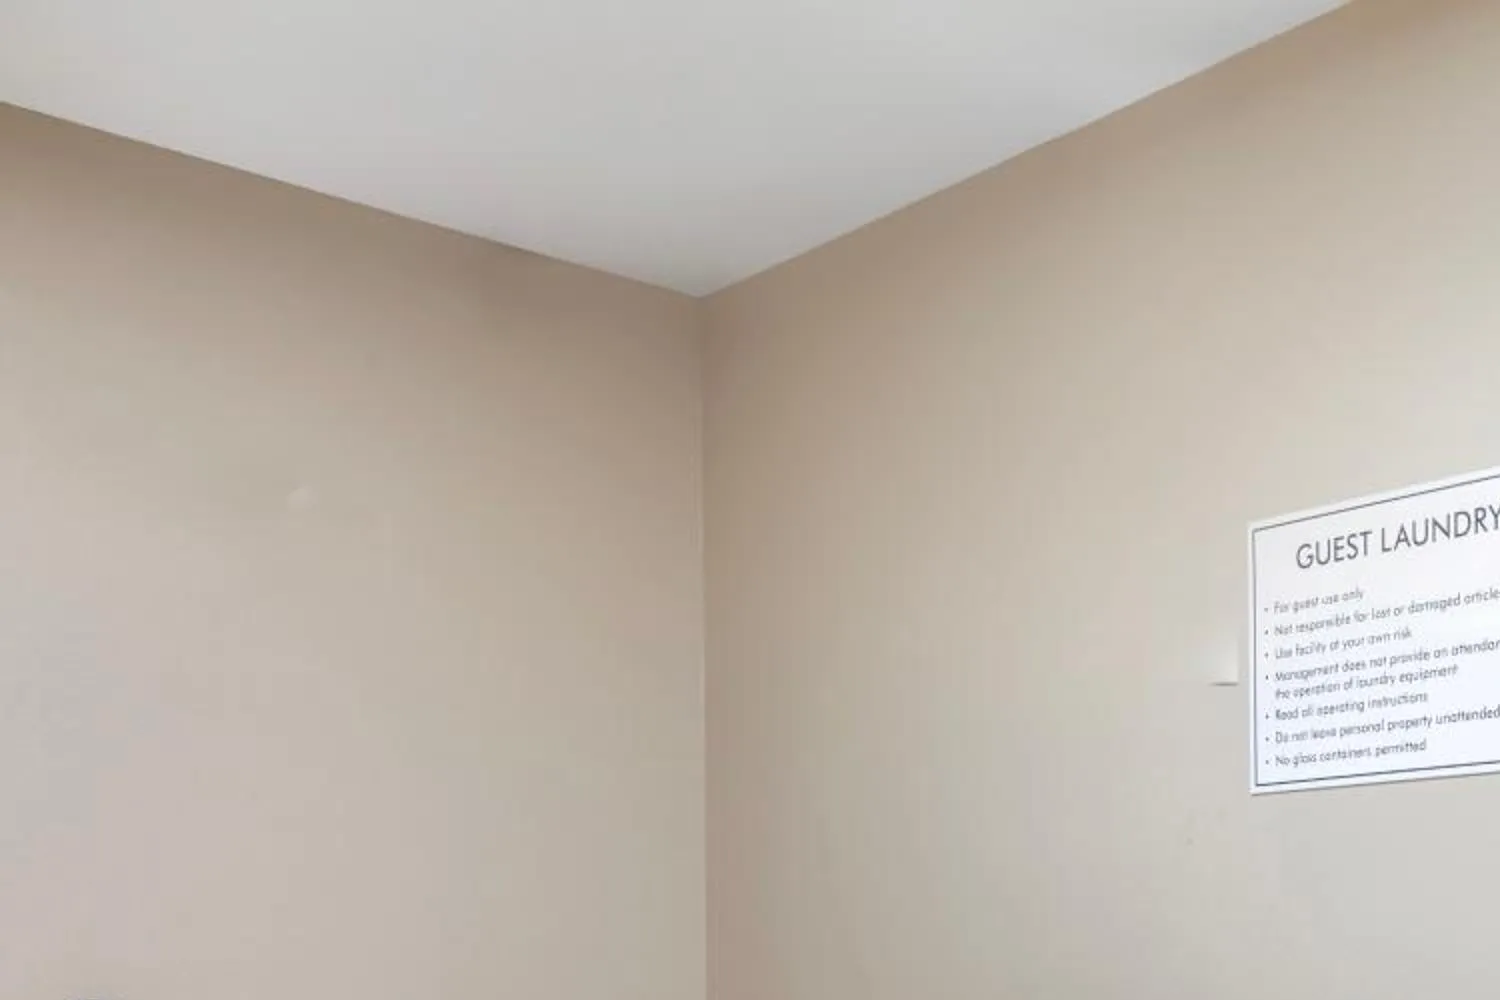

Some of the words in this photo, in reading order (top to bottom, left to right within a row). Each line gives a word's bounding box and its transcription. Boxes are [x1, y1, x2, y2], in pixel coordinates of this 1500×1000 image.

[1296, 530, 1372, 569] GUEST
[1274, 600, 1289, 613] For
[1292, 596, 1318, 614] guest
[1321, 594, 1340, 605] use
[1341, 587, 1364, 603] only
[1275, 624, 1293, 635] Not
[1296, 613, 1351, 634] responsible
[1353, 610, 1370, 622] for
[1371, 607, 1391, 620] lost
[1393, 606, 1405, 616] or
[1408, 592, 1460, 615] damaged
[1275, 647, 1293, 659] Use
[1296, 640, 1327, 655] facility
[1329, 640, 1340, 651] at
[1341, 637, 1365, 650] your
[1367, 633, 1391, 645] own
[1393, 627, 1411, 640] risk
[1275, 663, 1339, 681] Management
[1341, 659, 1367, 673] does
[1370, 656, 1387, 668] not
[1389, 648, 1430, 668] provide
[1433, 647, 1448, 658] an
[1275, 687, 1290, 699] the
[1293, 682, 1341, 698] operation
[1343, 677, 1354, 690] of
[1356, 672, 1396, 689] laundry
[1399, 664, 1459, 684] equipment
[1275, 706, 1299, 720] Read
[1301, 704, 1314, 717] all
[1317, 701, 1365, 718] operating
[1367, 692, 1428, 709] instructions
[1275, 731, 1289, 743] Do
[1291, 729, 1308, 741] not
[1310, 727, 1336, 739] leave
[1339, 718, 1385, 738] personal
[1387, 716, 1432, 732] property
[1435, 704, 1500, 724] unattended
[1275, 755, 1290, 766] No
[1292, 752, 1317, 768] glass
[1320, 746, 1371, 762] containers
[1375, 738, 1427, 757] permitted
